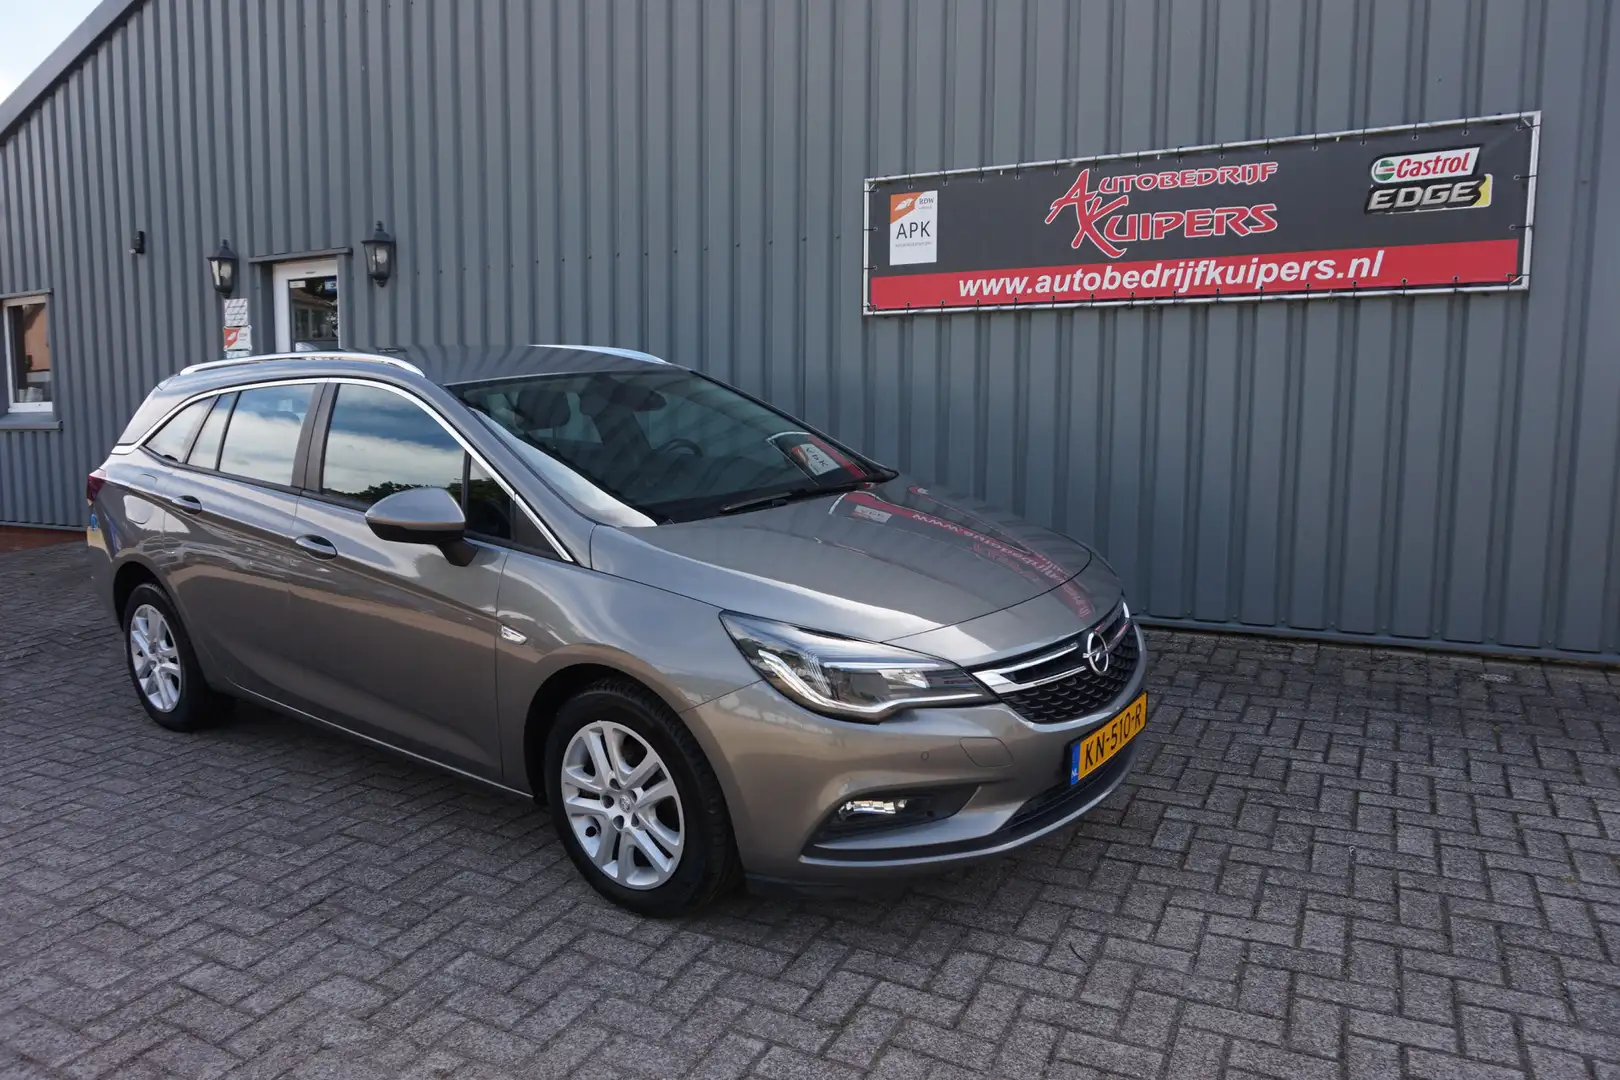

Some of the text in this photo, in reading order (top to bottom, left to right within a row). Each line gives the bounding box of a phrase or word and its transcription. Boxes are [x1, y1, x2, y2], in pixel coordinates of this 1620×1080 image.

[1396, 152, 1470, 179] Castrol
[1045, 162, 1279, 224] AUTOBEDRIJF
[1367, 180, 1480, 211] EDGE
[896, 220, 931, 240] APK
[1071, 195, 1278, 258] KUIPERS
[958, 250, 1385, 297] www.autobedrijfkuipers.nl
[1085, 703, 1142, 770] KN-510-R
